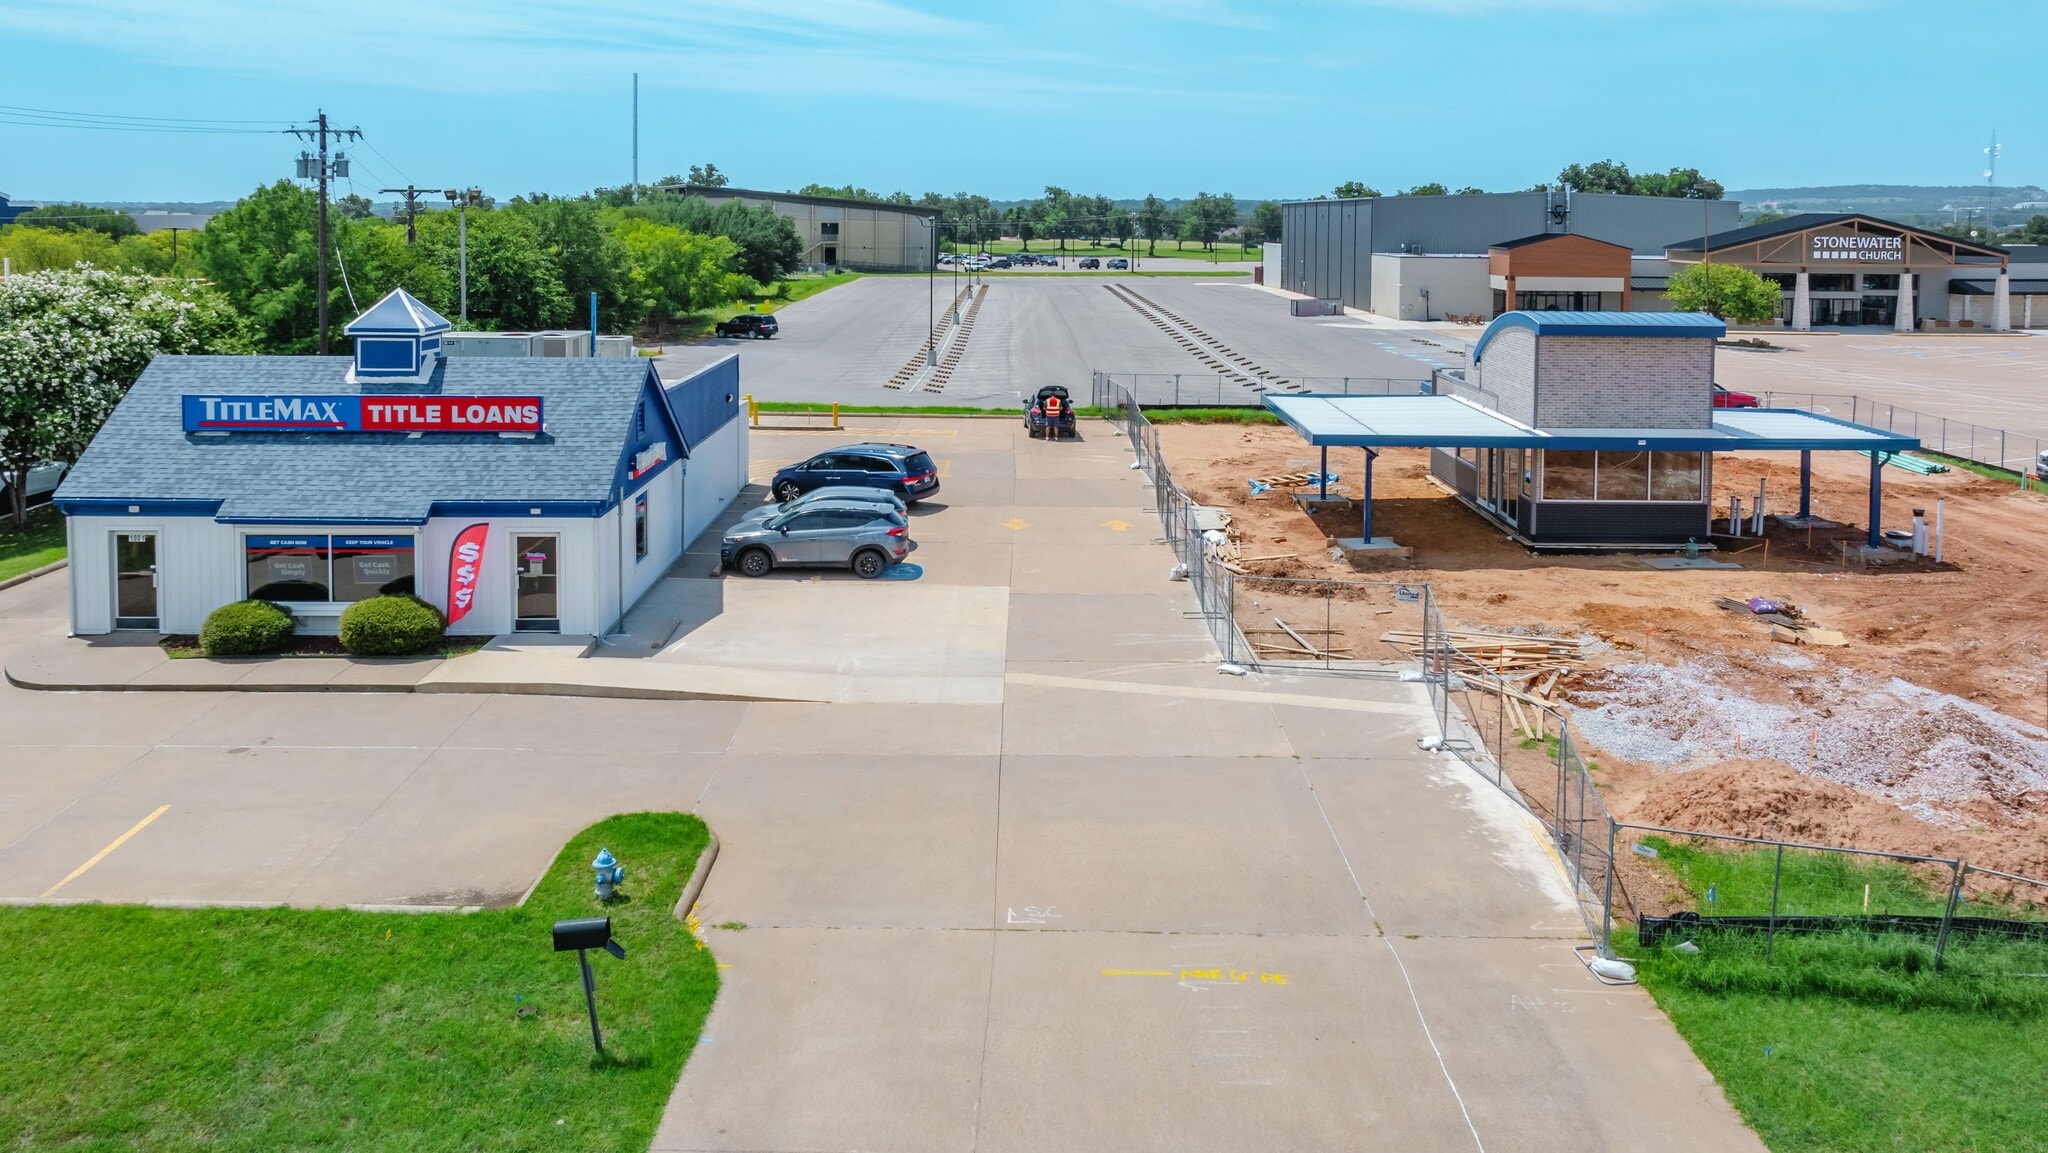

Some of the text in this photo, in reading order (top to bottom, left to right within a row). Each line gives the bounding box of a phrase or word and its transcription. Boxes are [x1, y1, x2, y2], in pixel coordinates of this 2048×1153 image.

[1813, 236, 1901, 249] STONEWATER
[1858, 250, 1901, 260] CHURCH
[367, 405, 539, 424] TITLE LOANS
